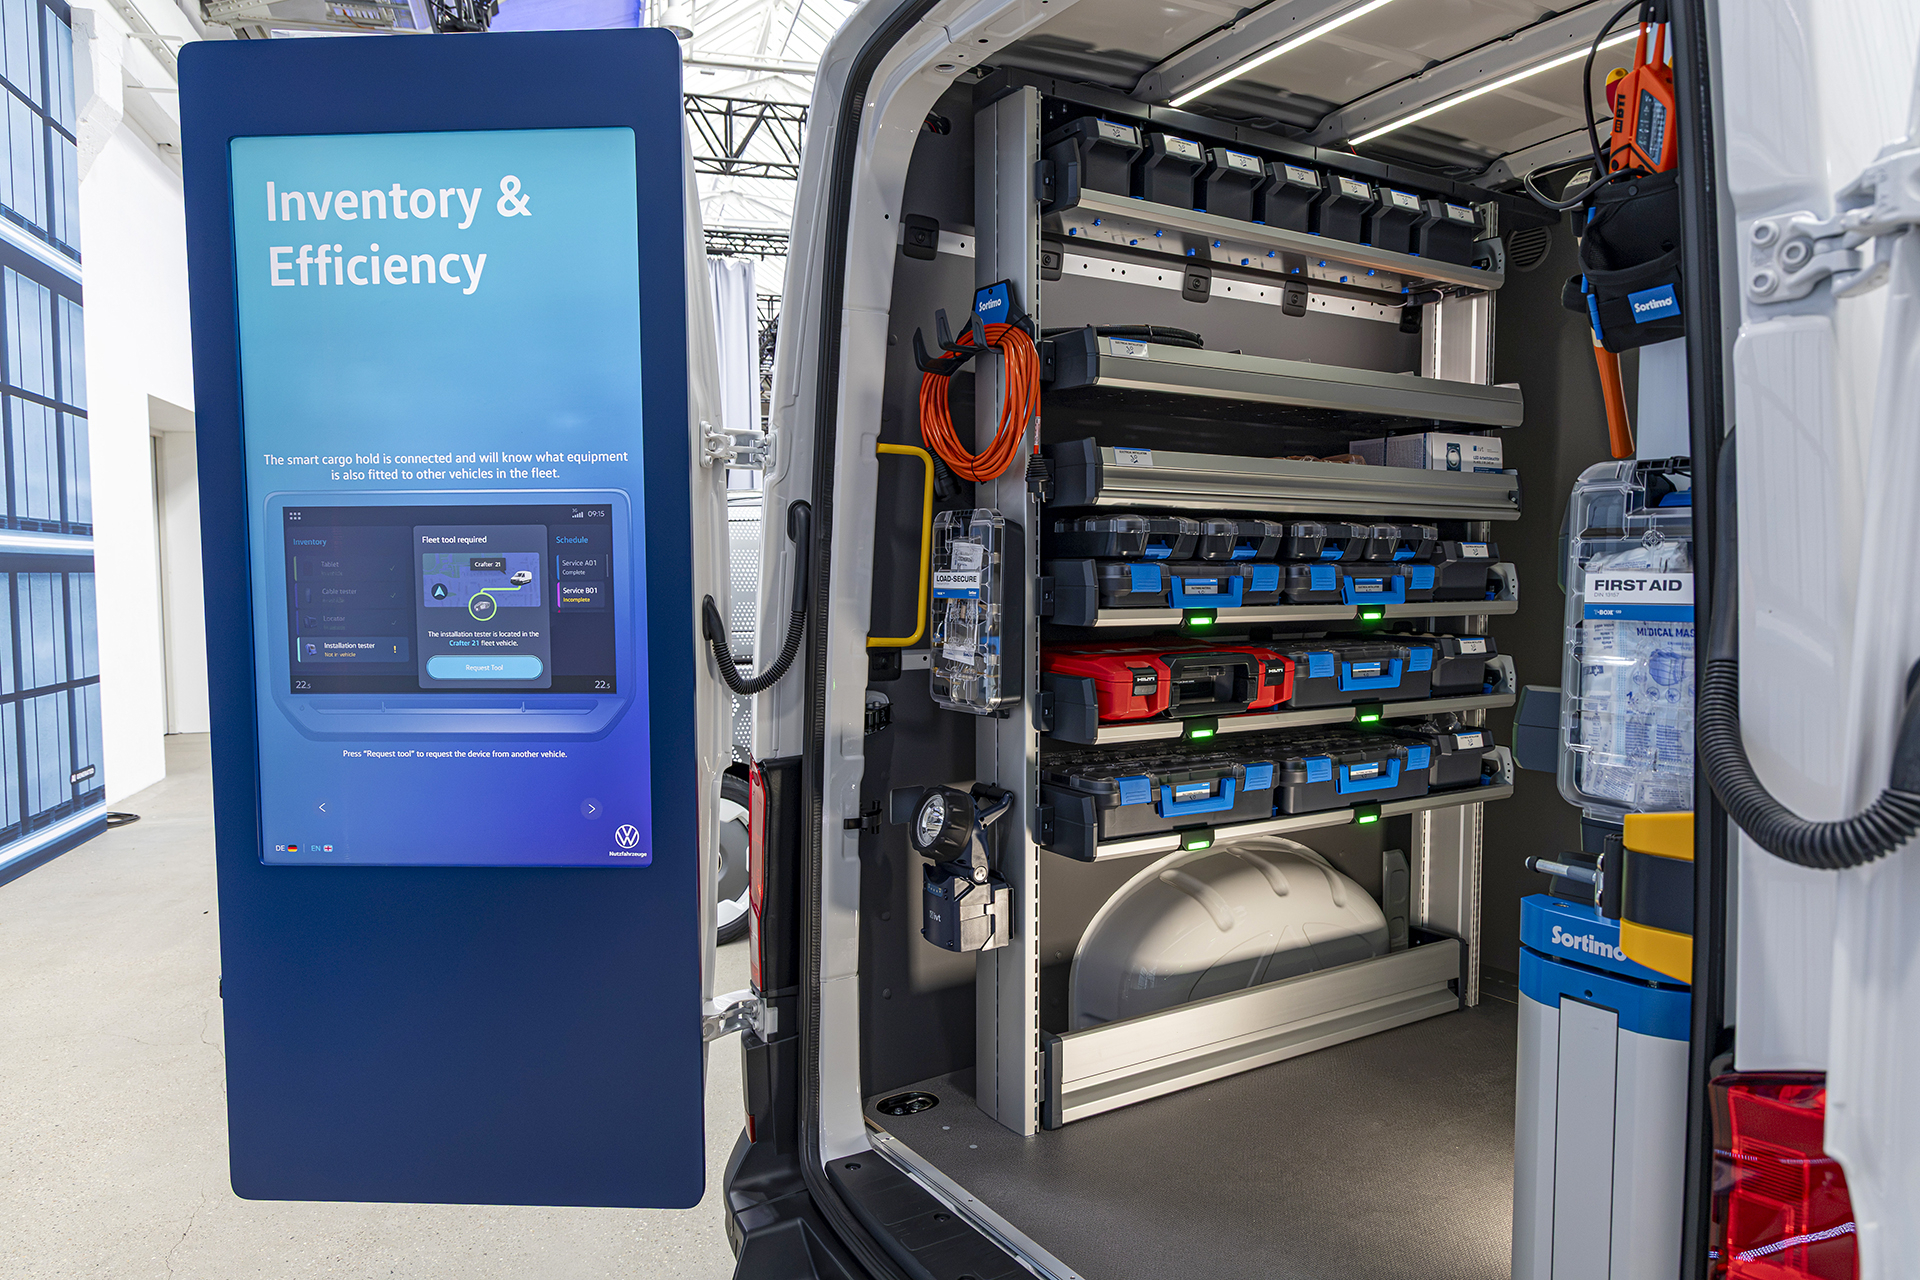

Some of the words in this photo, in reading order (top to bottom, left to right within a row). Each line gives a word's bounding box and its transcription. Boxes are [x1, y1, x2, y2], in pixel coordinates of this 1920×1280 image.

[266, 181, 482, 229] Inventory
[496, 174, 532, 217] &
[269, 243, 487, 295] Efficiency
[978, 298, 1001, 312] Sortimo
[1634, 296, 1672, 313] Sortimo
[264, 454, 284, 465] The
[287, 454, 319, 465] smart
[322, 456, 352, 467] cargo
[355, 453, 380, 464] hold
[382, 453, 392, 464] is
[394, 452, 452, 464] connected
[455, 452, 476, 464] and
[479, 452, 499, 463] will
[502, 452, 532, 463] know
[535, 451, 564, 462] what
[567, 451, 628, 464] equipment
[331, 470, 340, 480] is
[343, 469, 365, 480] also
[368, 468, 398, 480] fitted
[402, 470, 413, 480] to
[416, 469, 446, 480] other
[449, 468, 494, 479] vehicles
[496, 468, 506, 478] in
[510, 468, 528, 478] the
[531, 467, 560, 478] fleet.
[293, 538, 327, 547] Inventory
[422, 536, 440, 544] Fleet
[441, 536, 456, 544] tool
[458, 536, 488, 544] required
[1594, 580, 1647, 591] FIRST
[1649, 580, 1682, 591] AID
[363, 750, 395, 758] "Request
[1552, 925, 1626, 961] Sortimo
